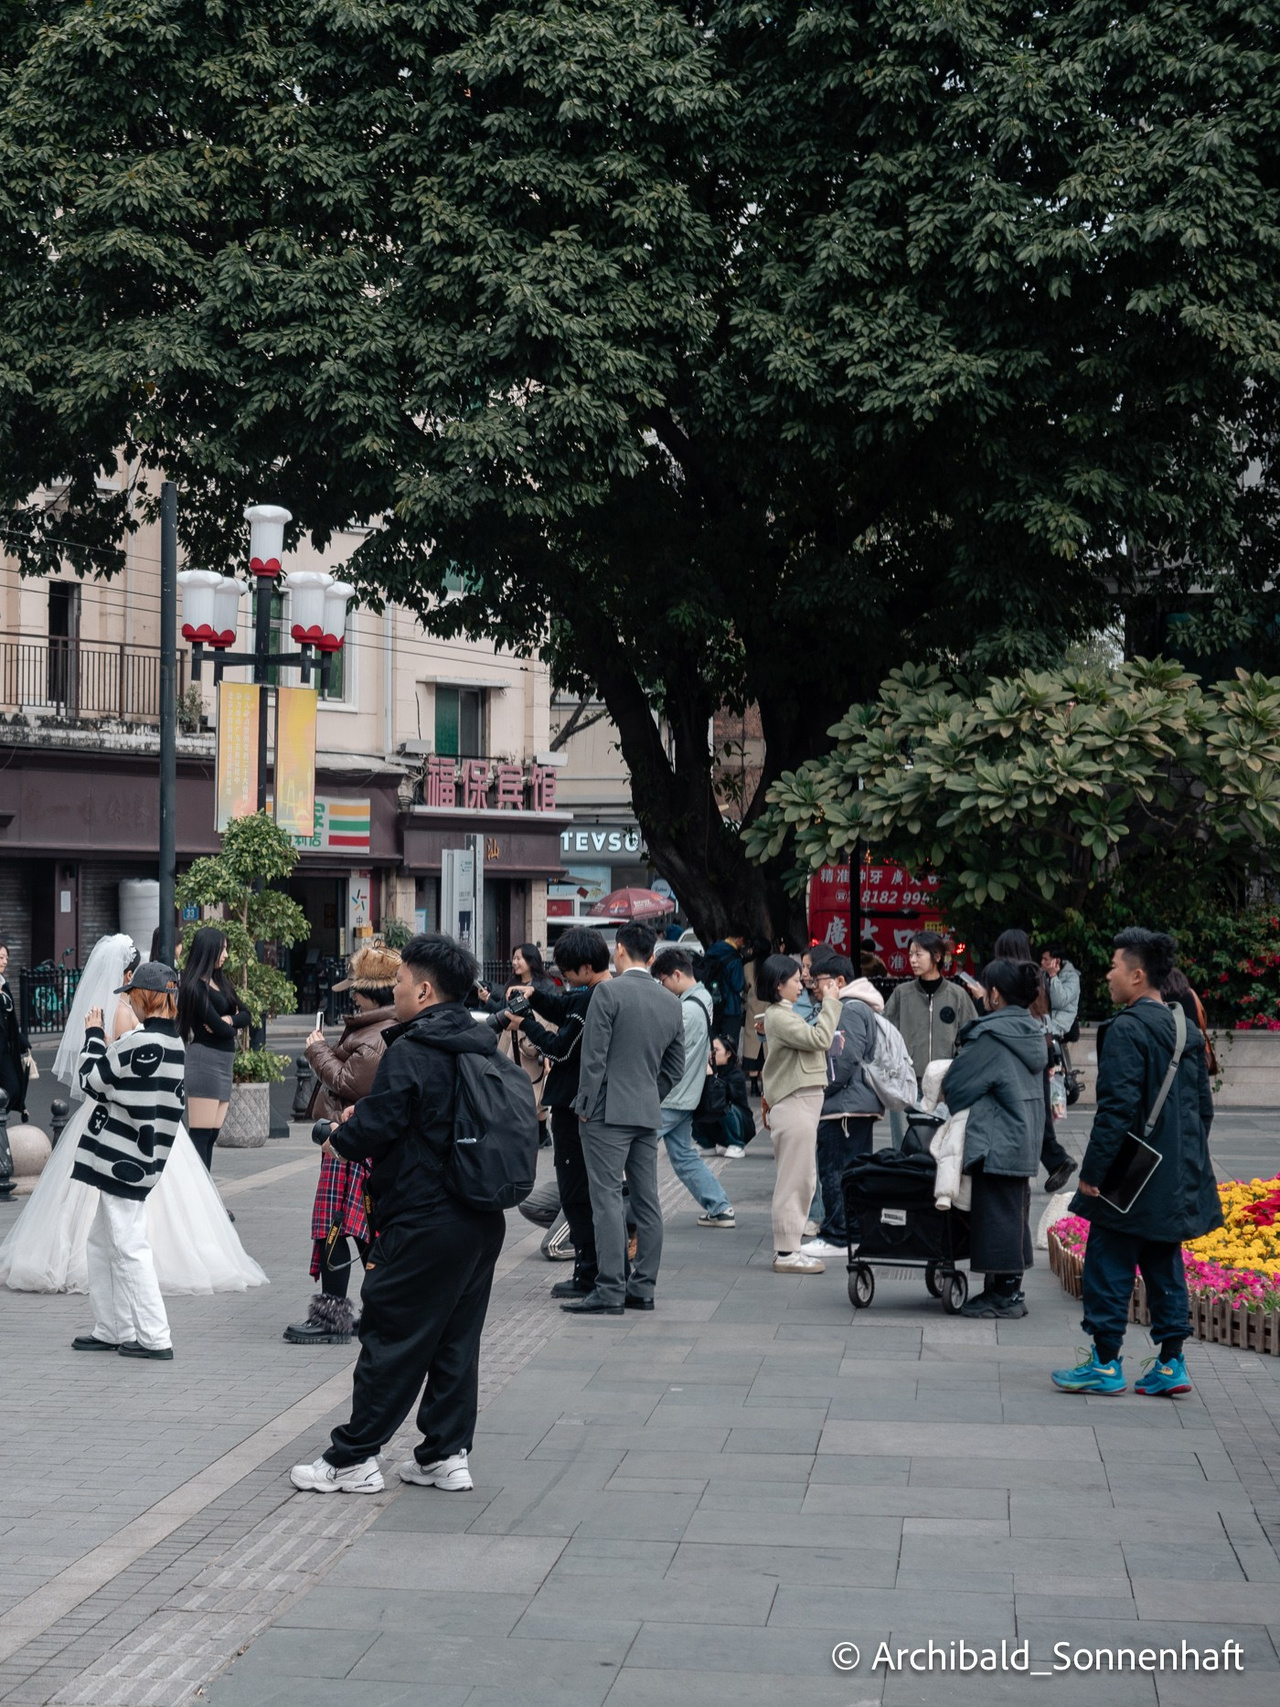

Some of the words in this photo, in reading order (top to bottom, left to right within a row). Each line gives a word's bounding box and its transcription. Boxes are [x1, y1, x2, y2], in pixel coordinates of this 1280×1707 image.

[427, 757, 557, 812] 福保宾馆
[282, 832, 322, 847] 利店
[483, 837, 500, 862] 汕
[862, 890, 898, 904] 8182
[902, 890, 939, 905] 99
